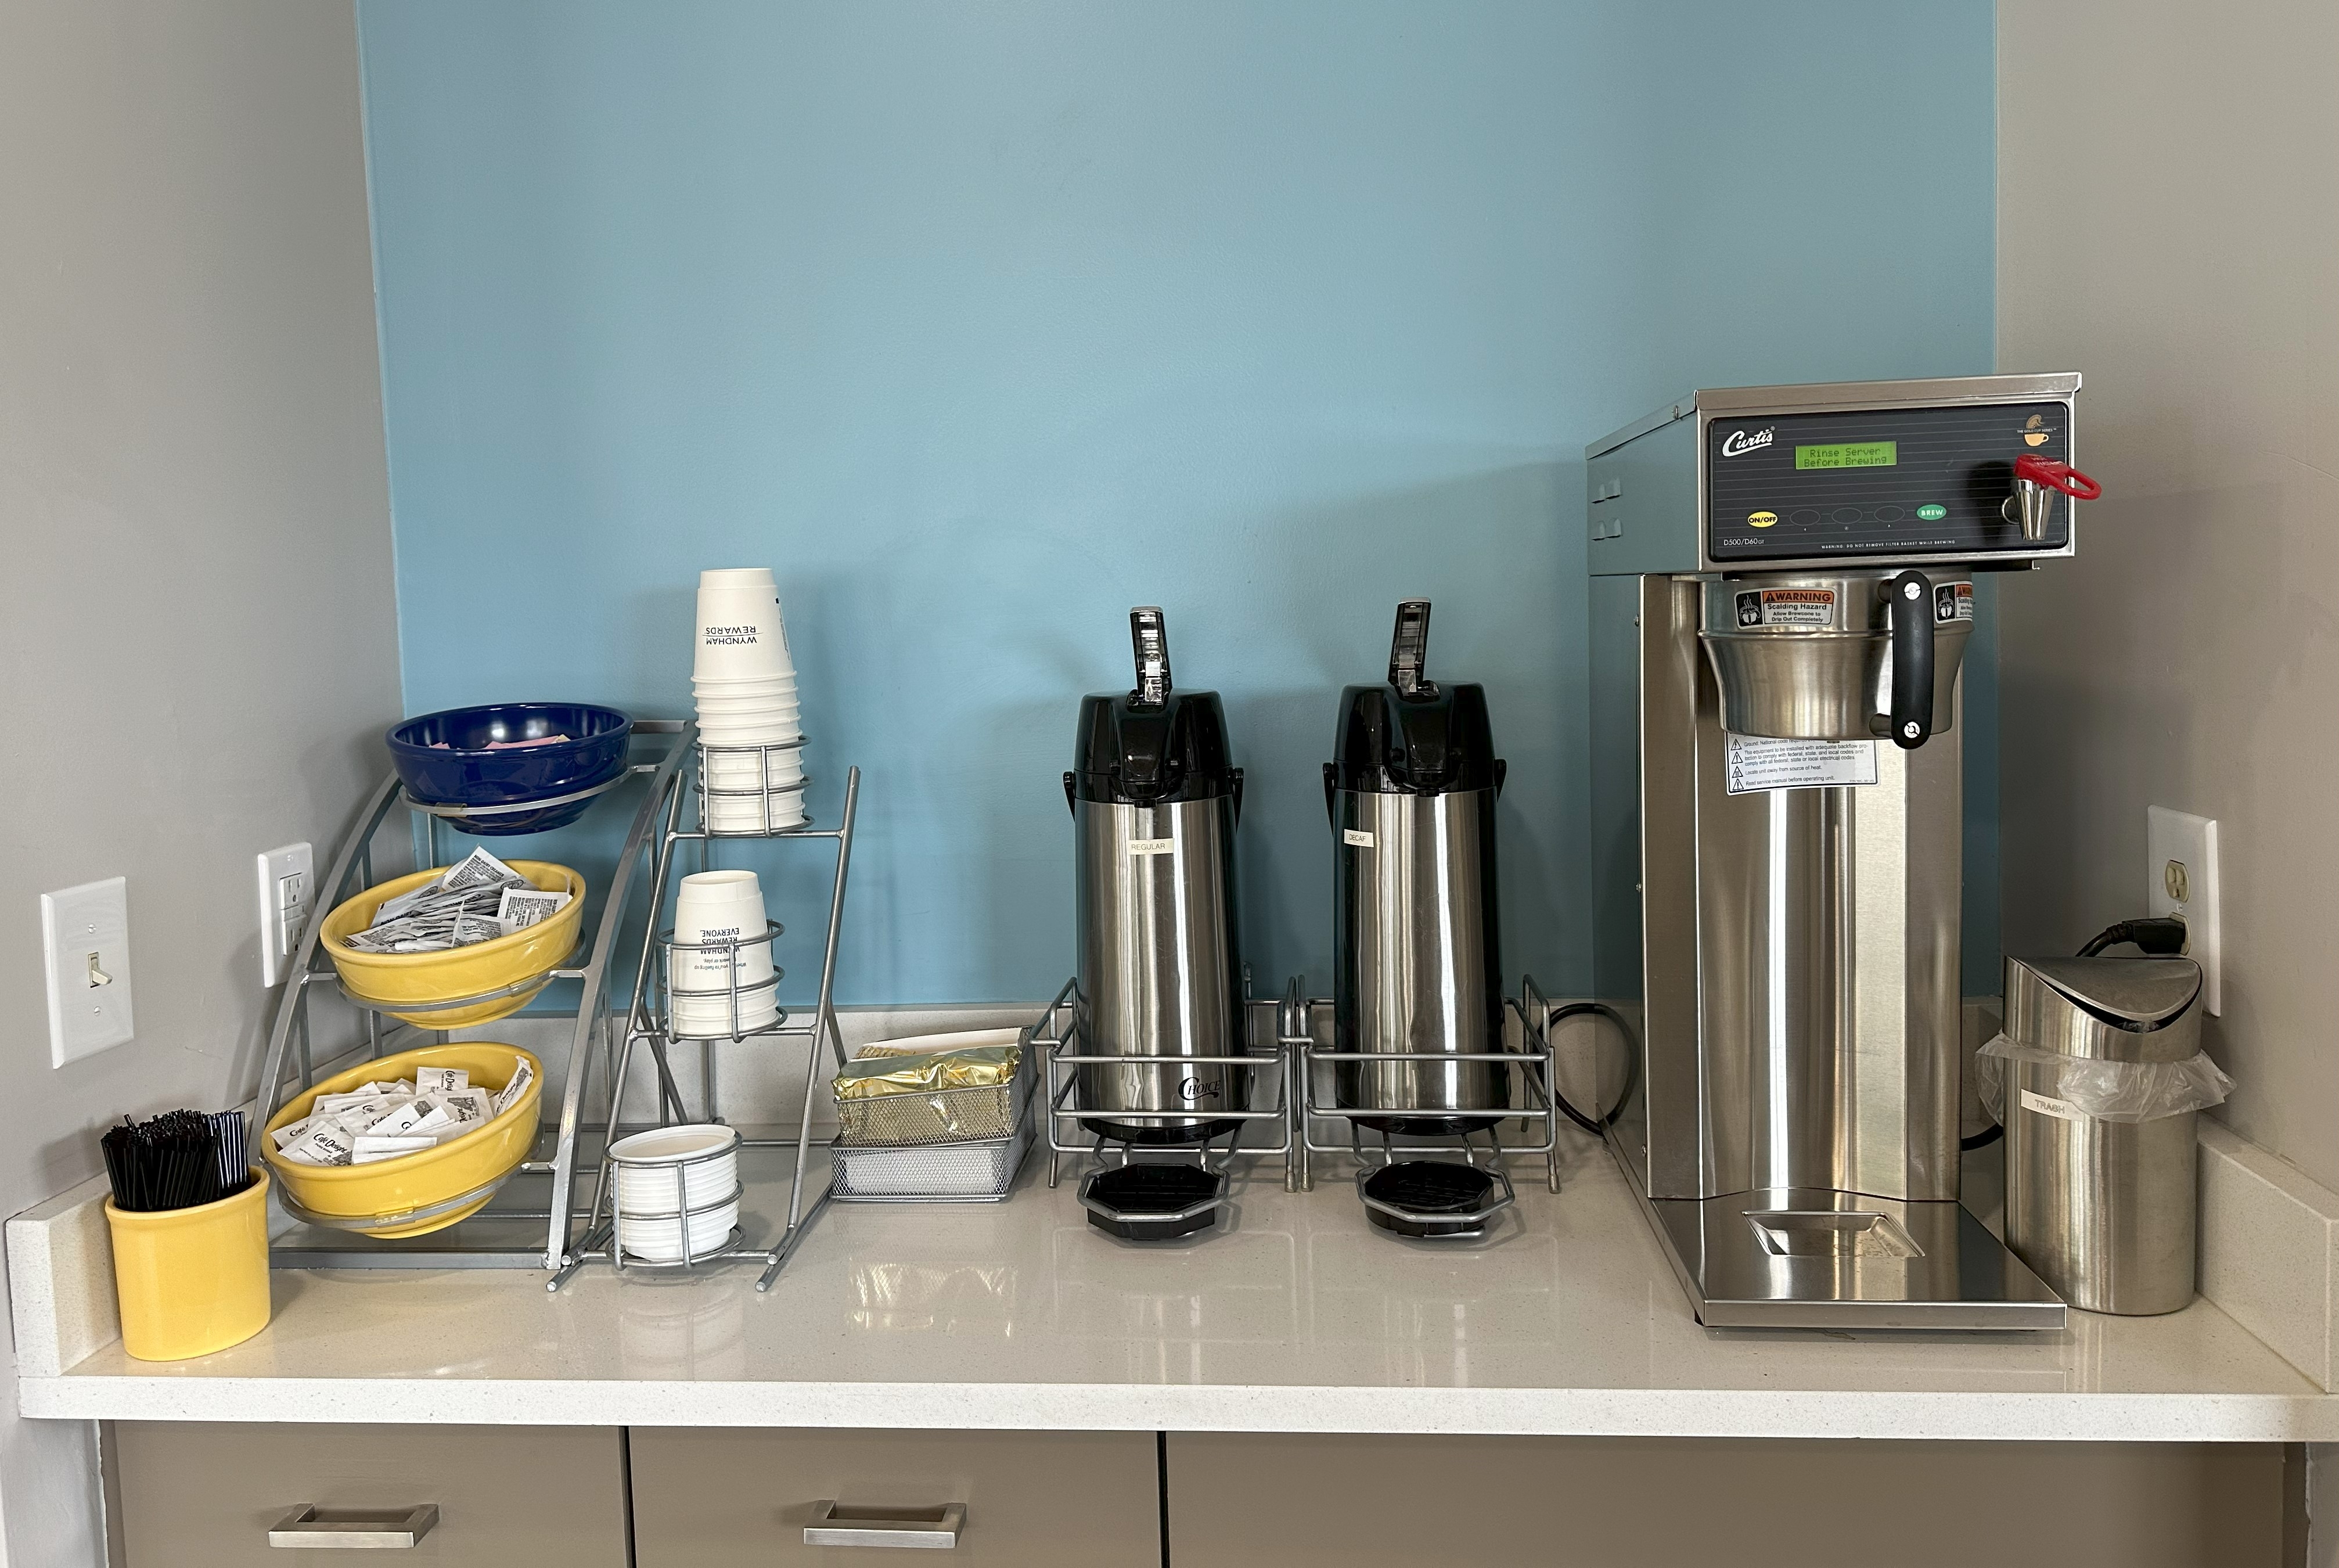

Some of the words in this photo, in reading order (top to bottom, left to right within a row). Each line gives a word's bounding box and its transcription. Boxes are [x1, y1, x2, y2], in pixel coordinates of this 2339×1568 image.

[1722, 429, 1772, 456] Curtis
[1845, 448, 1881, 456] Server
[1845, 456, 1887, 465] Brewing
[1776, 592, 1831, 601] WARNING
[706, 626, 755, 634] REWARDS
[706, 636, 757, 645] WYNDHAM
[2035, 1099, 2065, 1114] TRASH
[314, 1133, 329, 1143] Café
[325, 1139, 347, 1153] Delight
